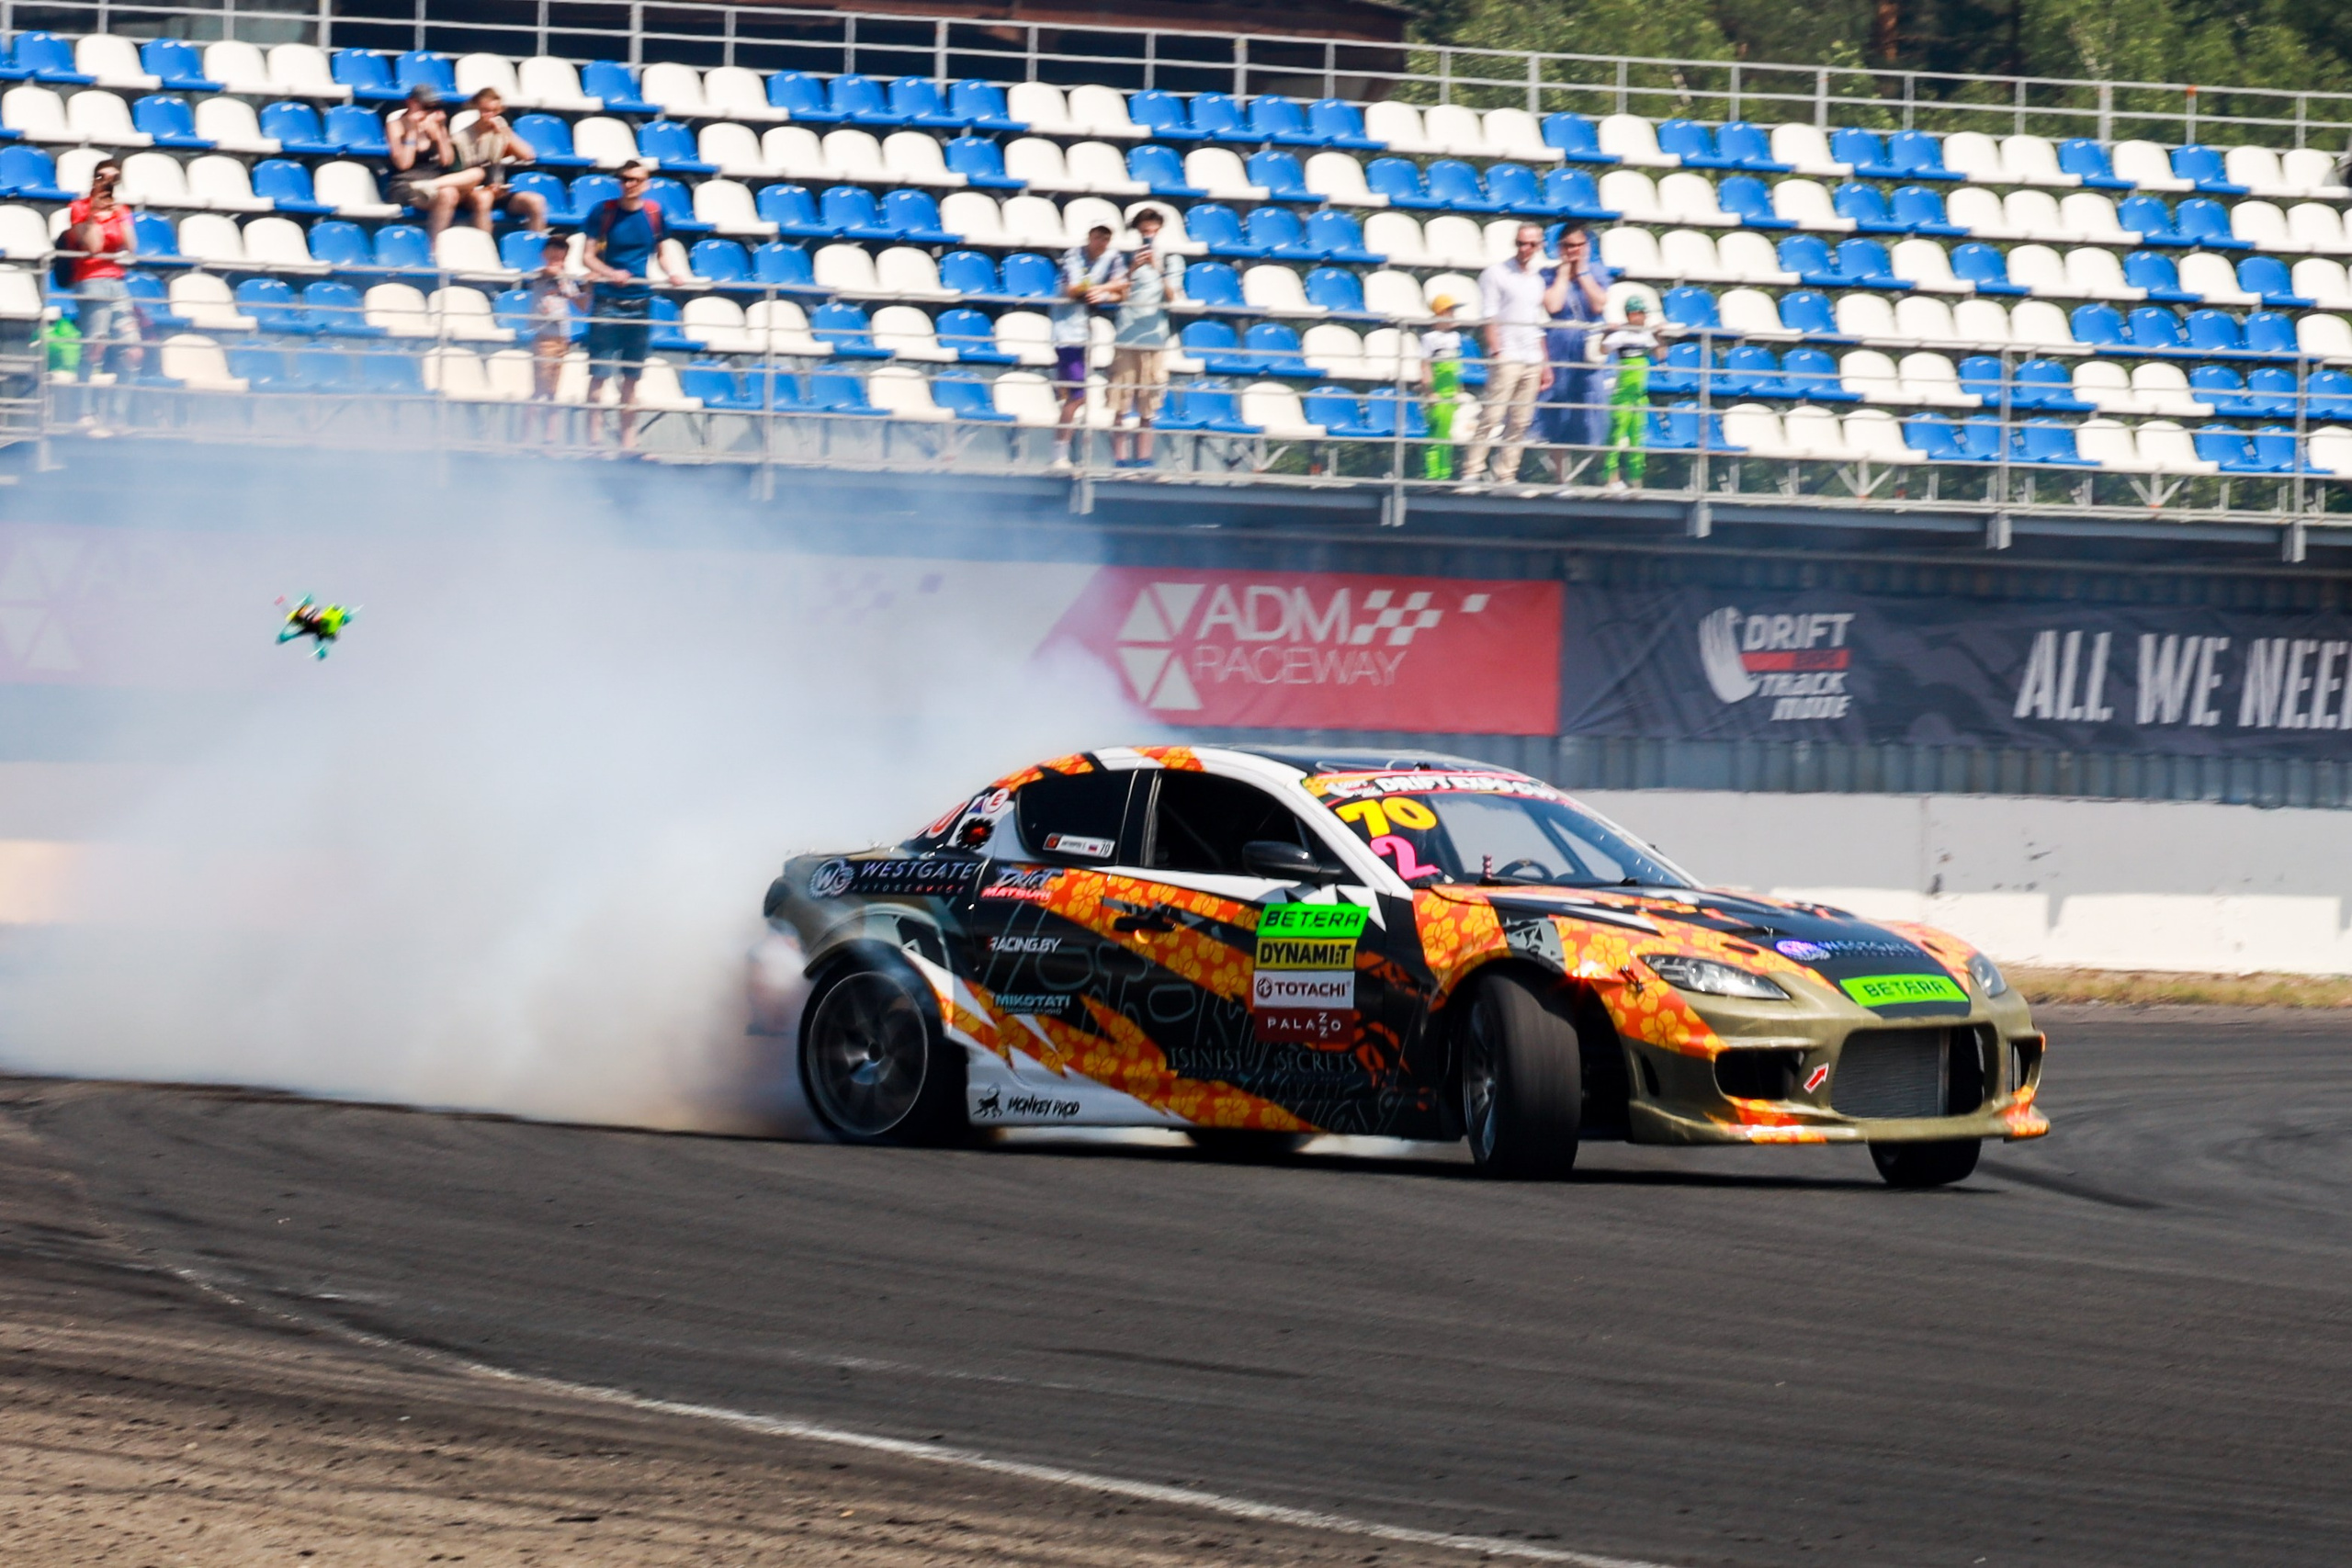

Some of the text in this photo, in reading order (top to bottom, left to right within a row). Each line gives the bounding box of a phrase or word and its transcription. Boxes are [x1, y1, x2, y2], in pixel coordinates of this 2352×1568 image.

[1195, 584, 1351, 643] ADM
[1743, 613, 1855, 651] DRIFT
[1194, 645, 1408, 687] RACEWAY
[2013, 630, 2352, 730] ALL WE NEE
[1375, 776, 1451, 792] DRIFT
[1335, 796, 1437, 838] 70
[1370, 835, 1439, 880] 2
[860, 861, 978, 880] WESTGATE
[1264, 910, 1361, 929] BETERA
[1274, 982, 1346, 998] TOTACHI
[1863, 979, 1950, 998] BETERA
[995, 993, 1071, 1009] MIKOTATI
[1007, 1093, 1052, 1117] MONKEY
